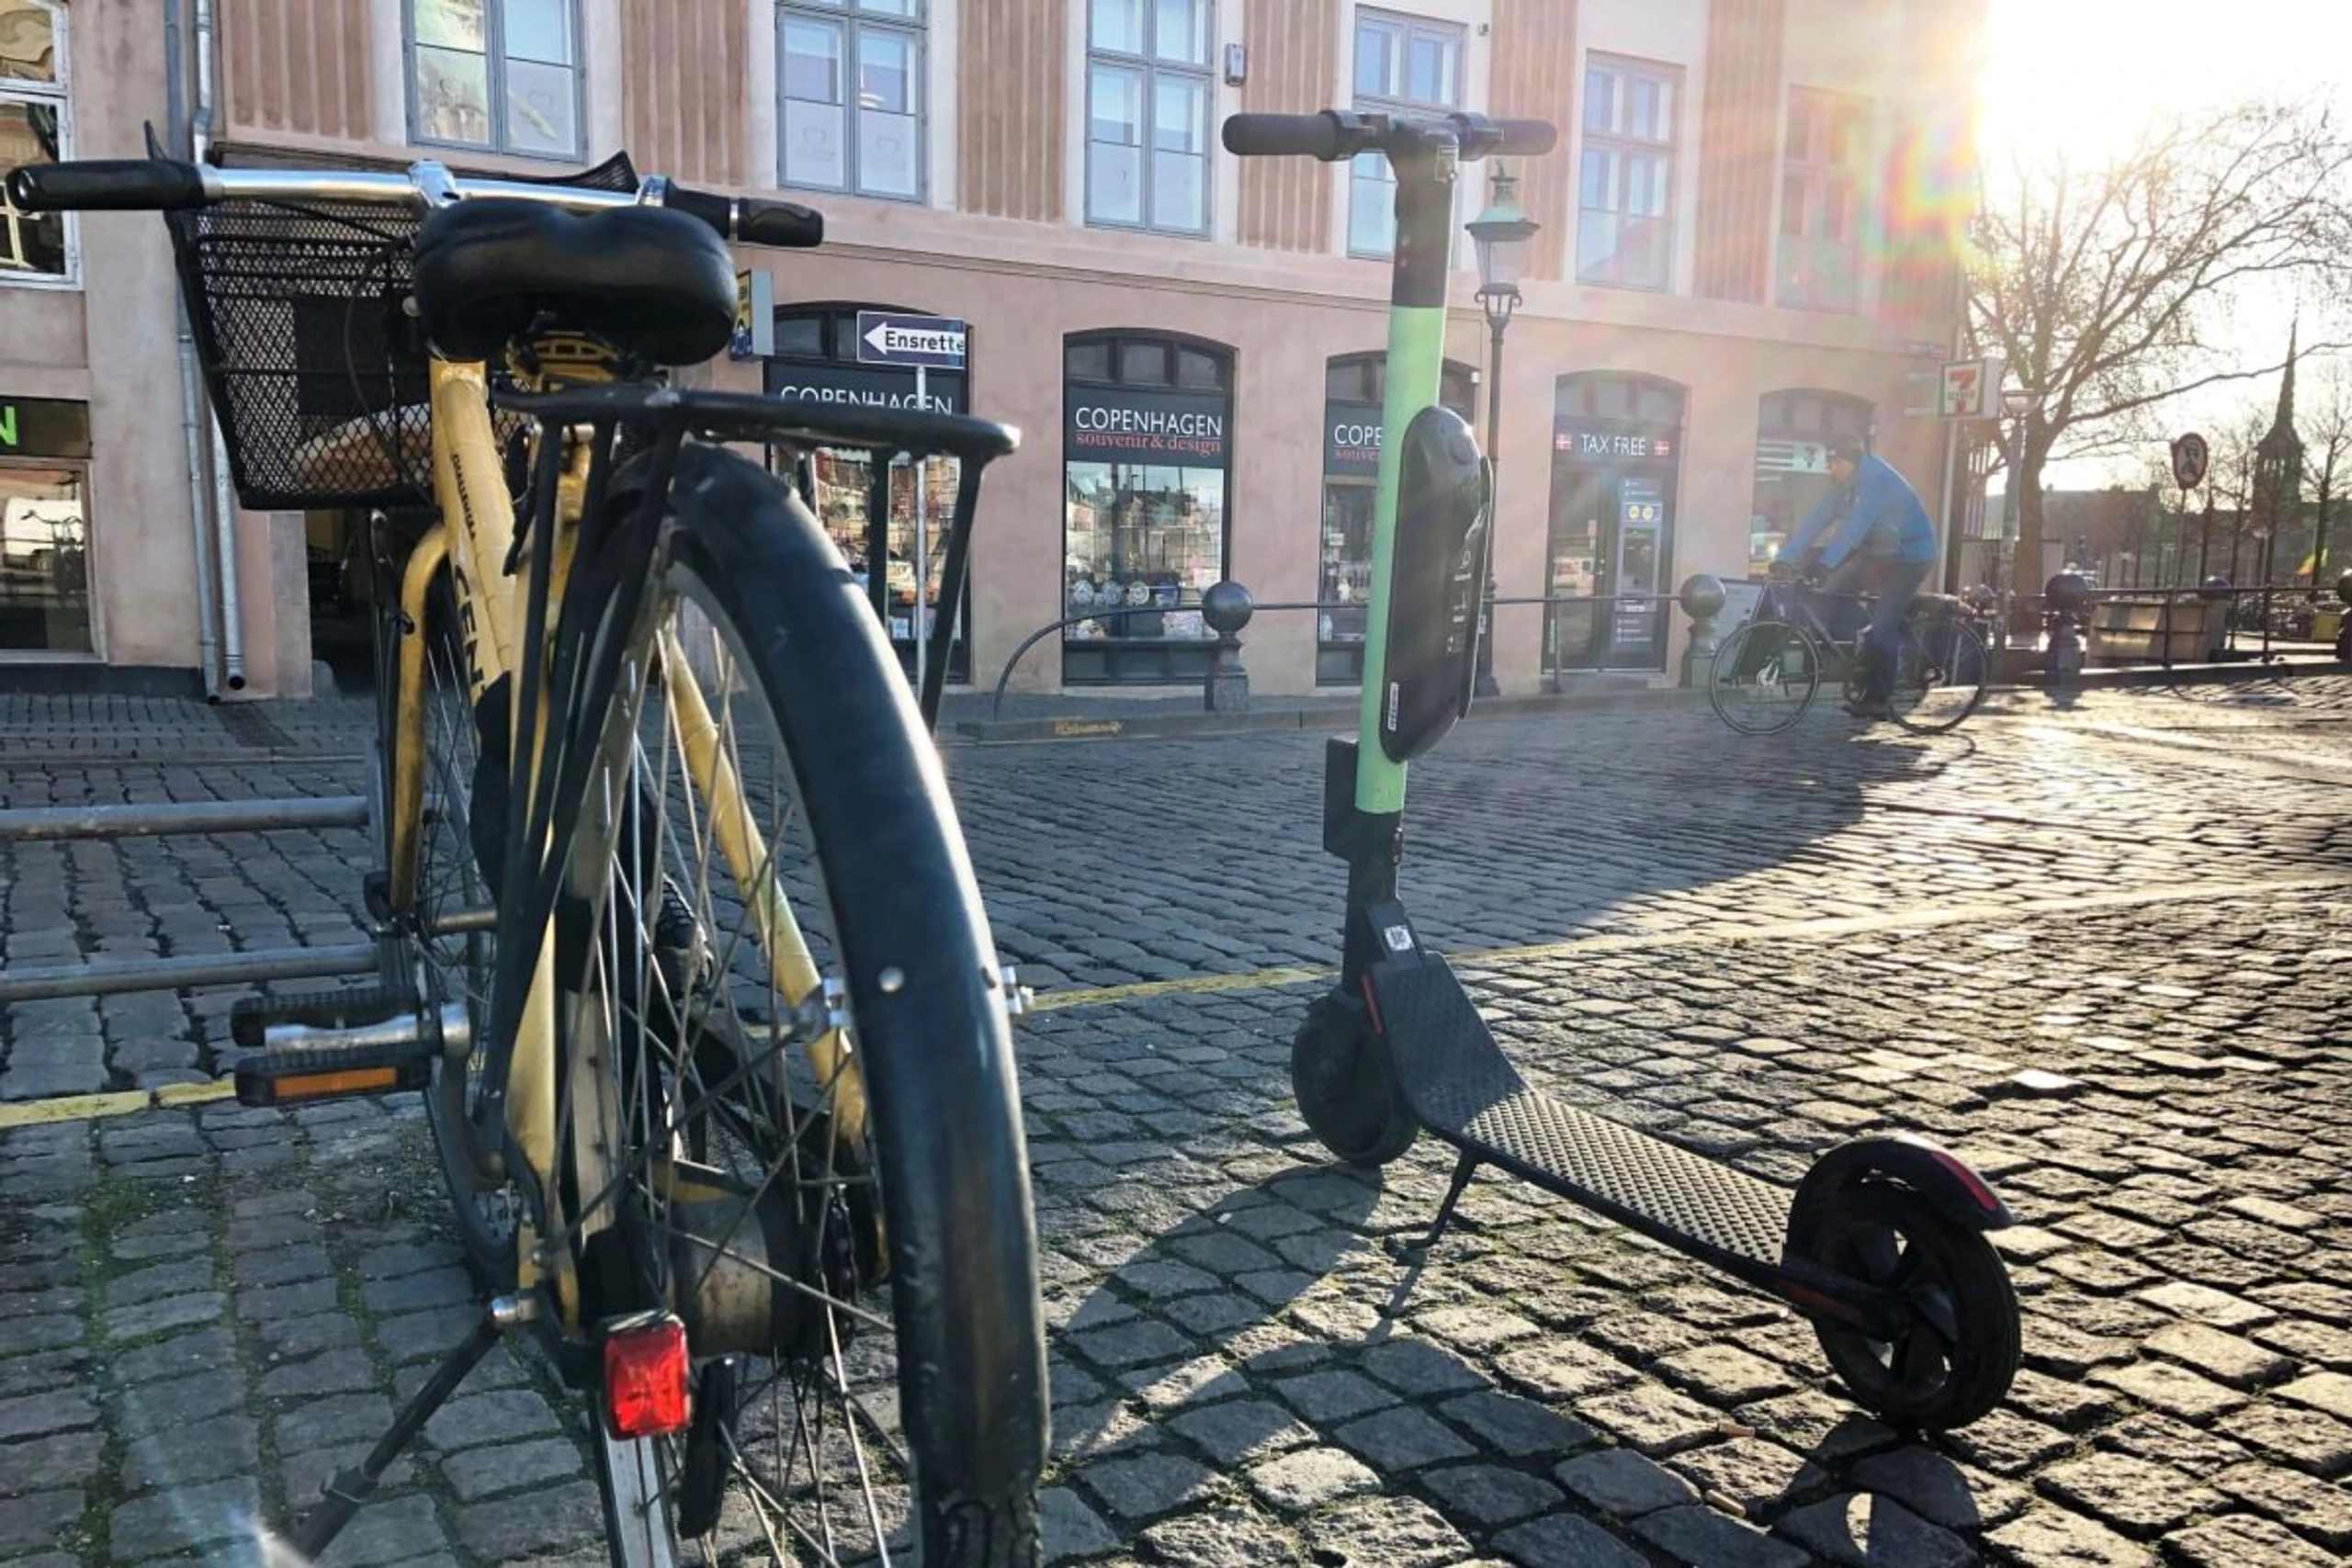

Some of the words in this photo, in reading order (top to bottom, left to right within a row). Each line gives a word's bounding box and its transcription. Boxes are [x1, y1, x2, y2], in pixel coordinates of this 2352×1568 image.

[885, 330, 964, 353] Ensrette
[1075, 407, 1223, 436] COPENHAGEN
[1076, 433, 1148, 448] souvenir
[1150, 434, 1164, 449] &
[1168, 435, 1222, 456] design
[1334, 424, 1382, 446] COPE
[1580, 434, 1610, 454] TAX
[1613, 435, 1646, 456] FREE
